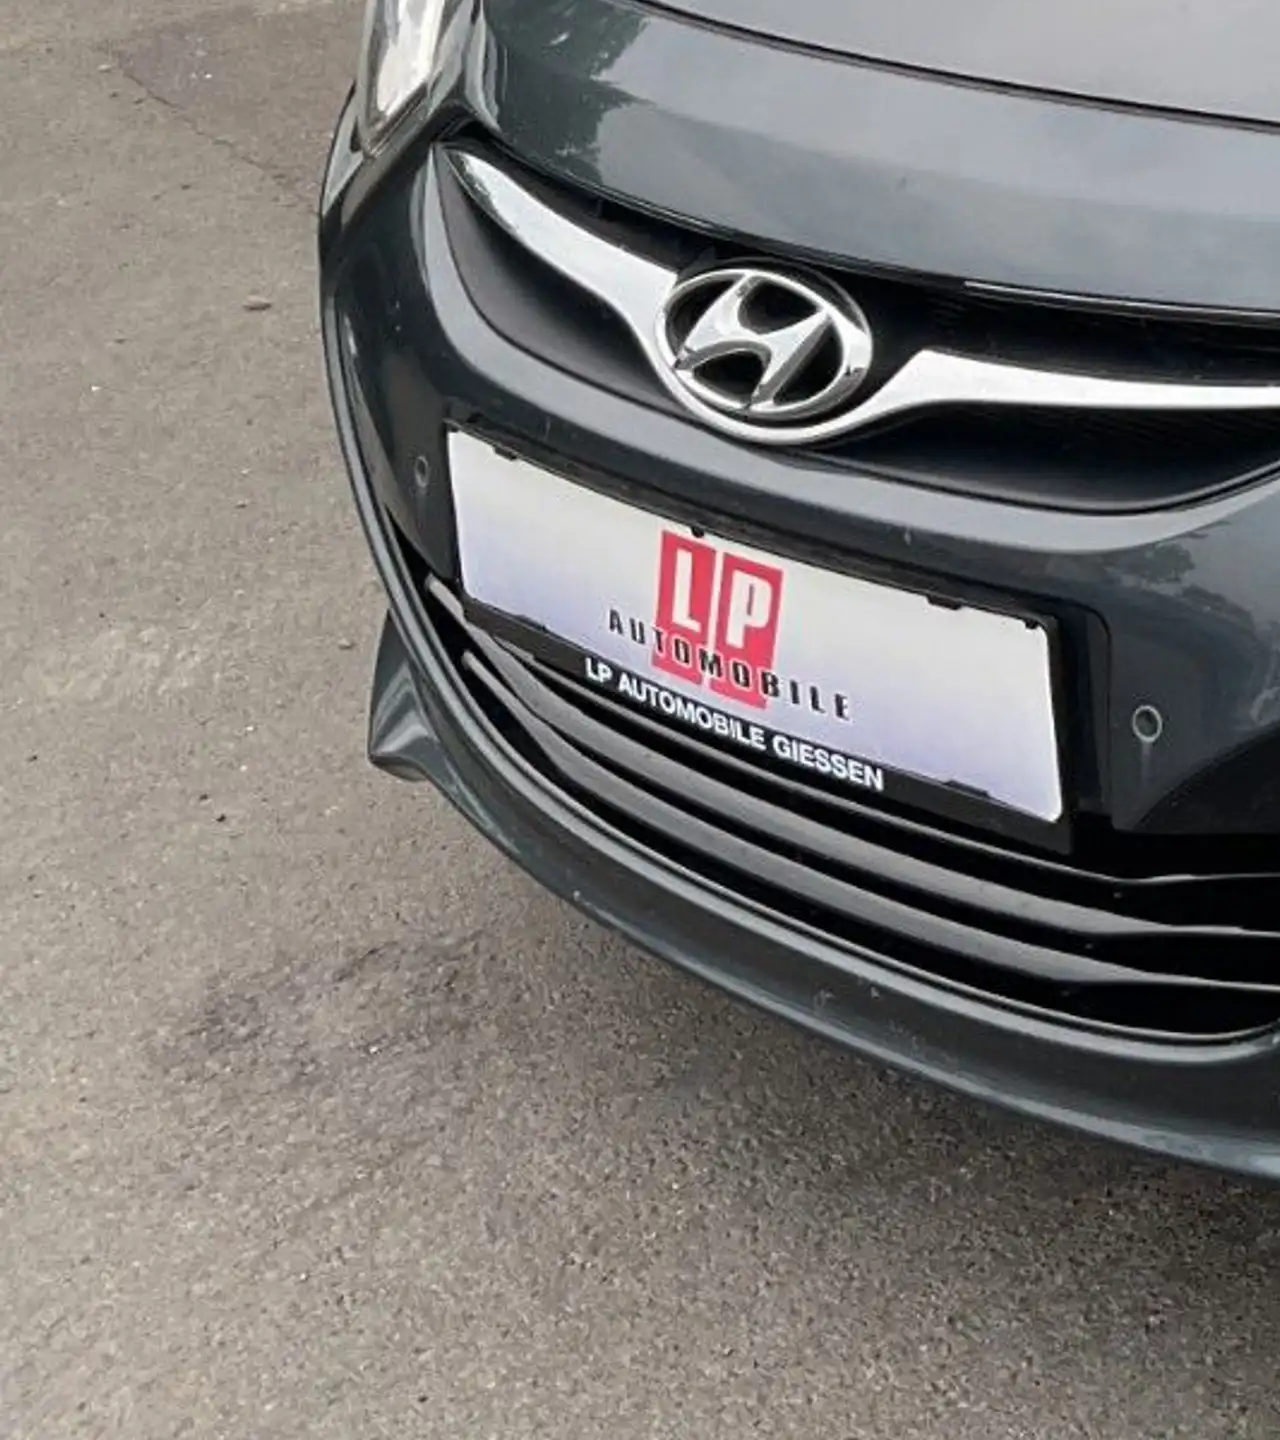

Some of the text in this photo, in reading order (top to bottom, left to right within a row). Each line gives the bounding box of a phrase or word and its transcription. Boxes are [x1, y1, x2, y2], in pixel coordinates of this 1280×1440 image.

[672, 548, 773, 649] LP
[608, 609, 851, 721] AUTOMOBILE
[585, 657, 885, 792] LP AUTOMOBILE GIESSEN
